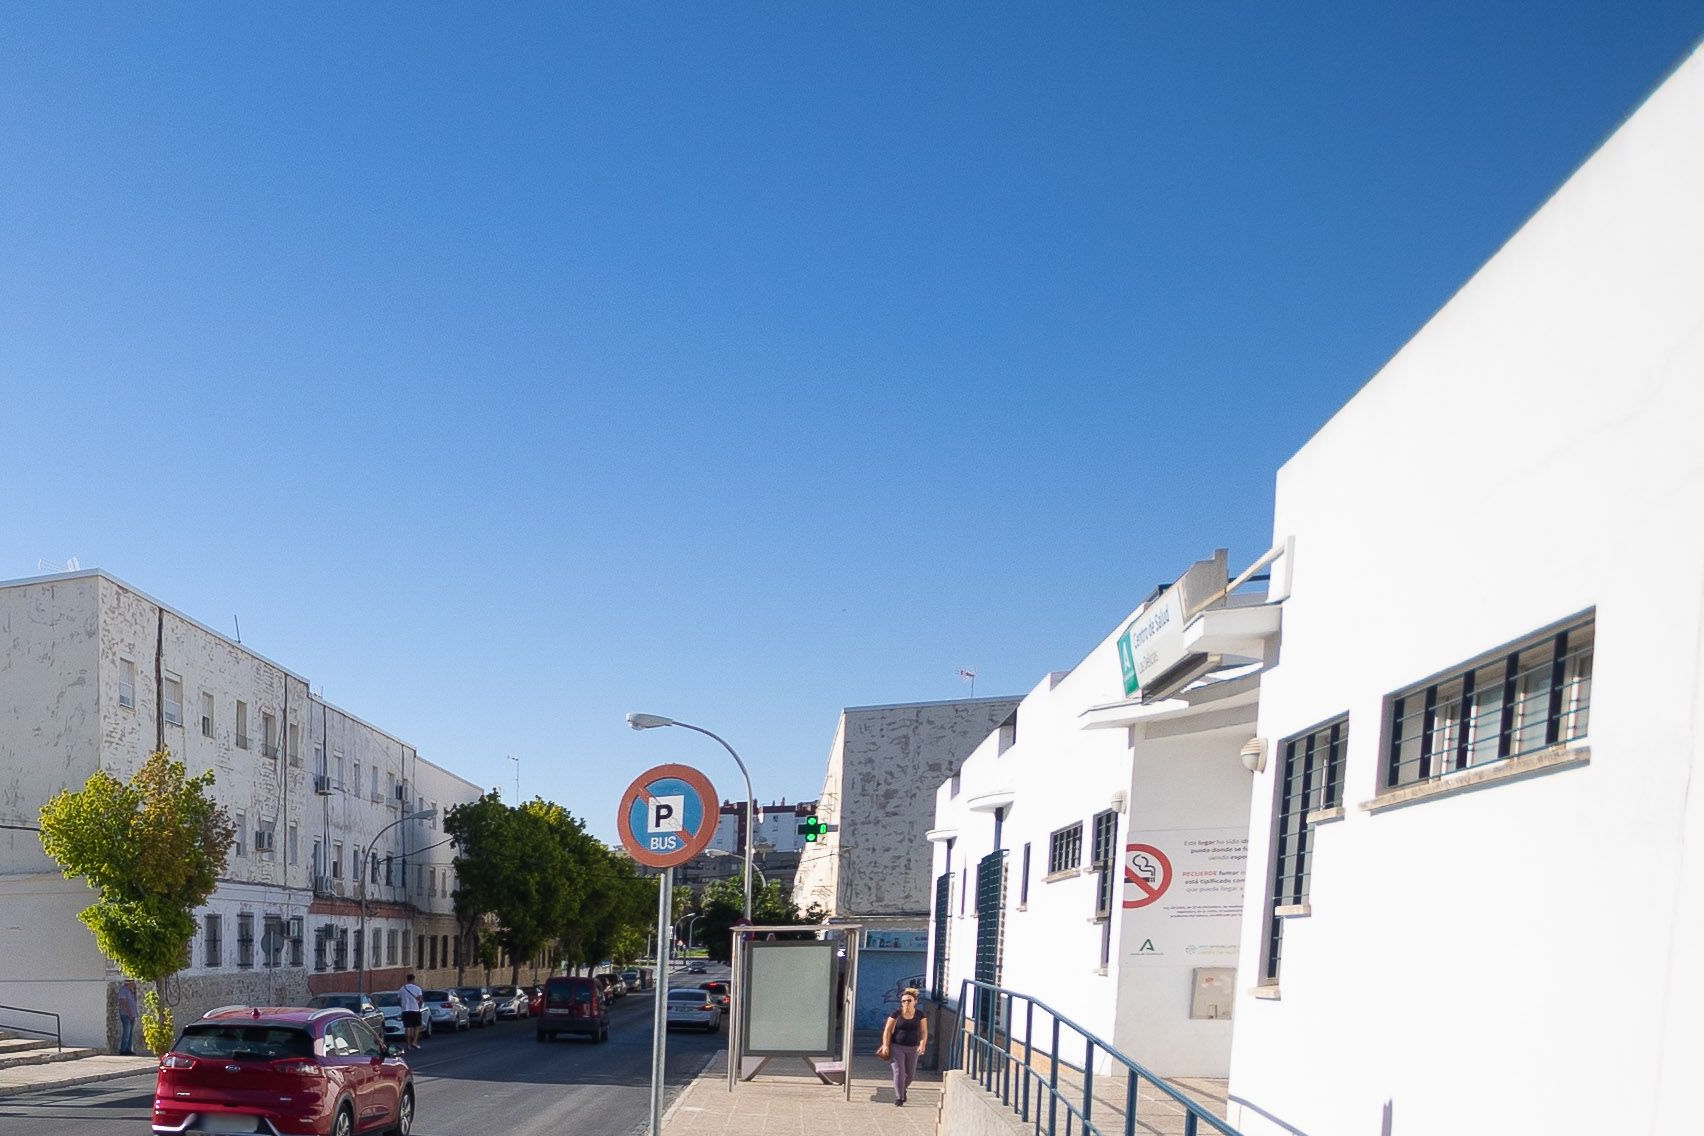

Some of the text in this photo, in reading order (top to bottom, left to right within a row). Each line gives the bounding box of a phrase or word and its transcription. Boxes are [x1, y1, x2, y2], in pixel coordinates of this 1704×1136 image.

[1133, 626, 1149, 649] Centro
[1155, 603, 1170, 631] Salud
[654, 803, 674, 829] P
[650, 836, 677, 850] BUS
